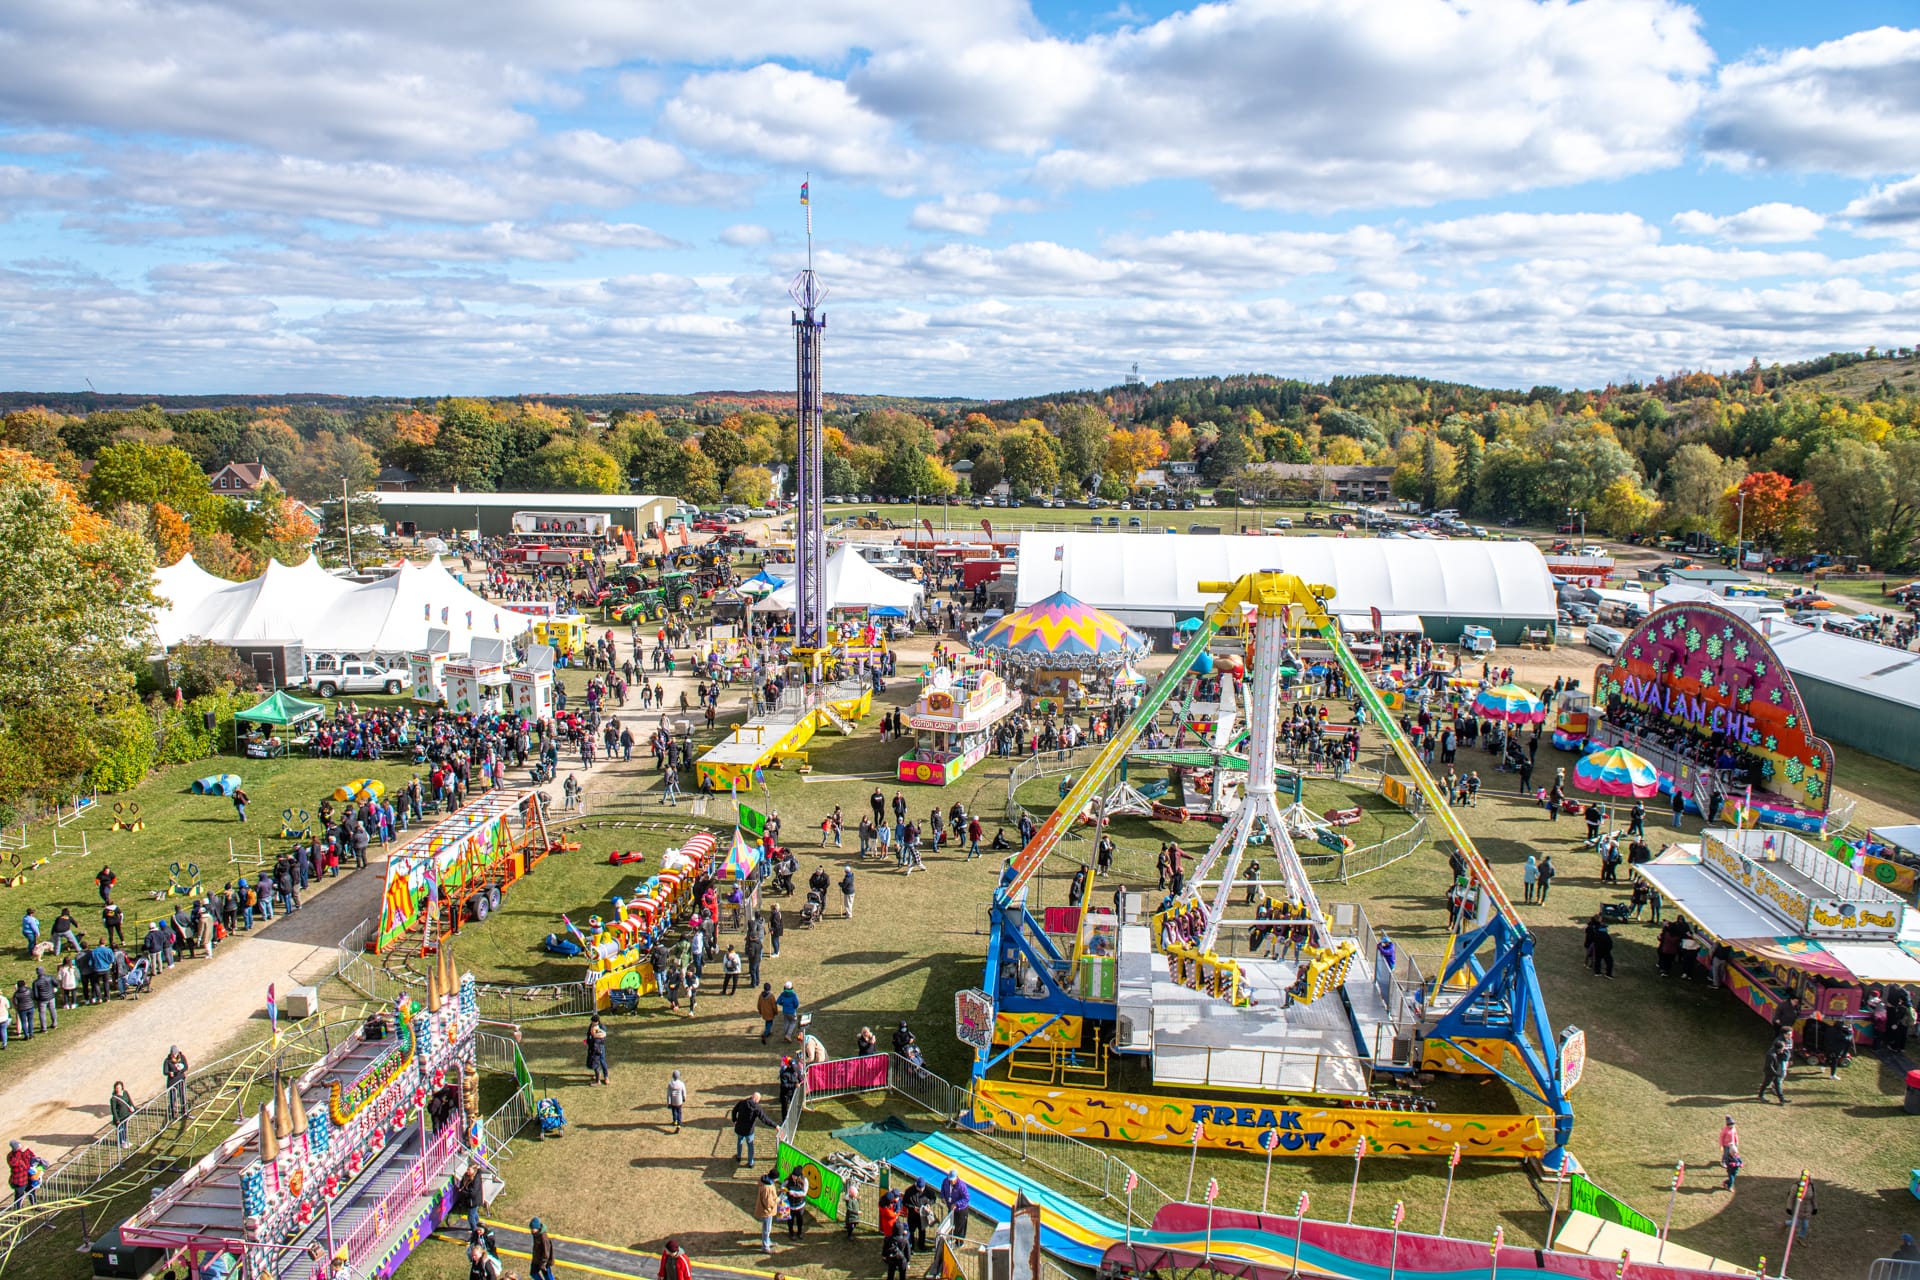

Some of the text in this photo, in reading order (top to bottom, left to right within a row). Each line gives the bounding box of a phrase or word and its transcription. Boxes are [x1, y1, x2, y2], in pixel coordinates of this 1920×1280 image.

[913, 719, 934, 728] COTTON
[934, 722, 952, 730] CANDY
[1191, 1104, 1304, 1131] FREAK
[1257, 1130, 1326, 1151] OUT
